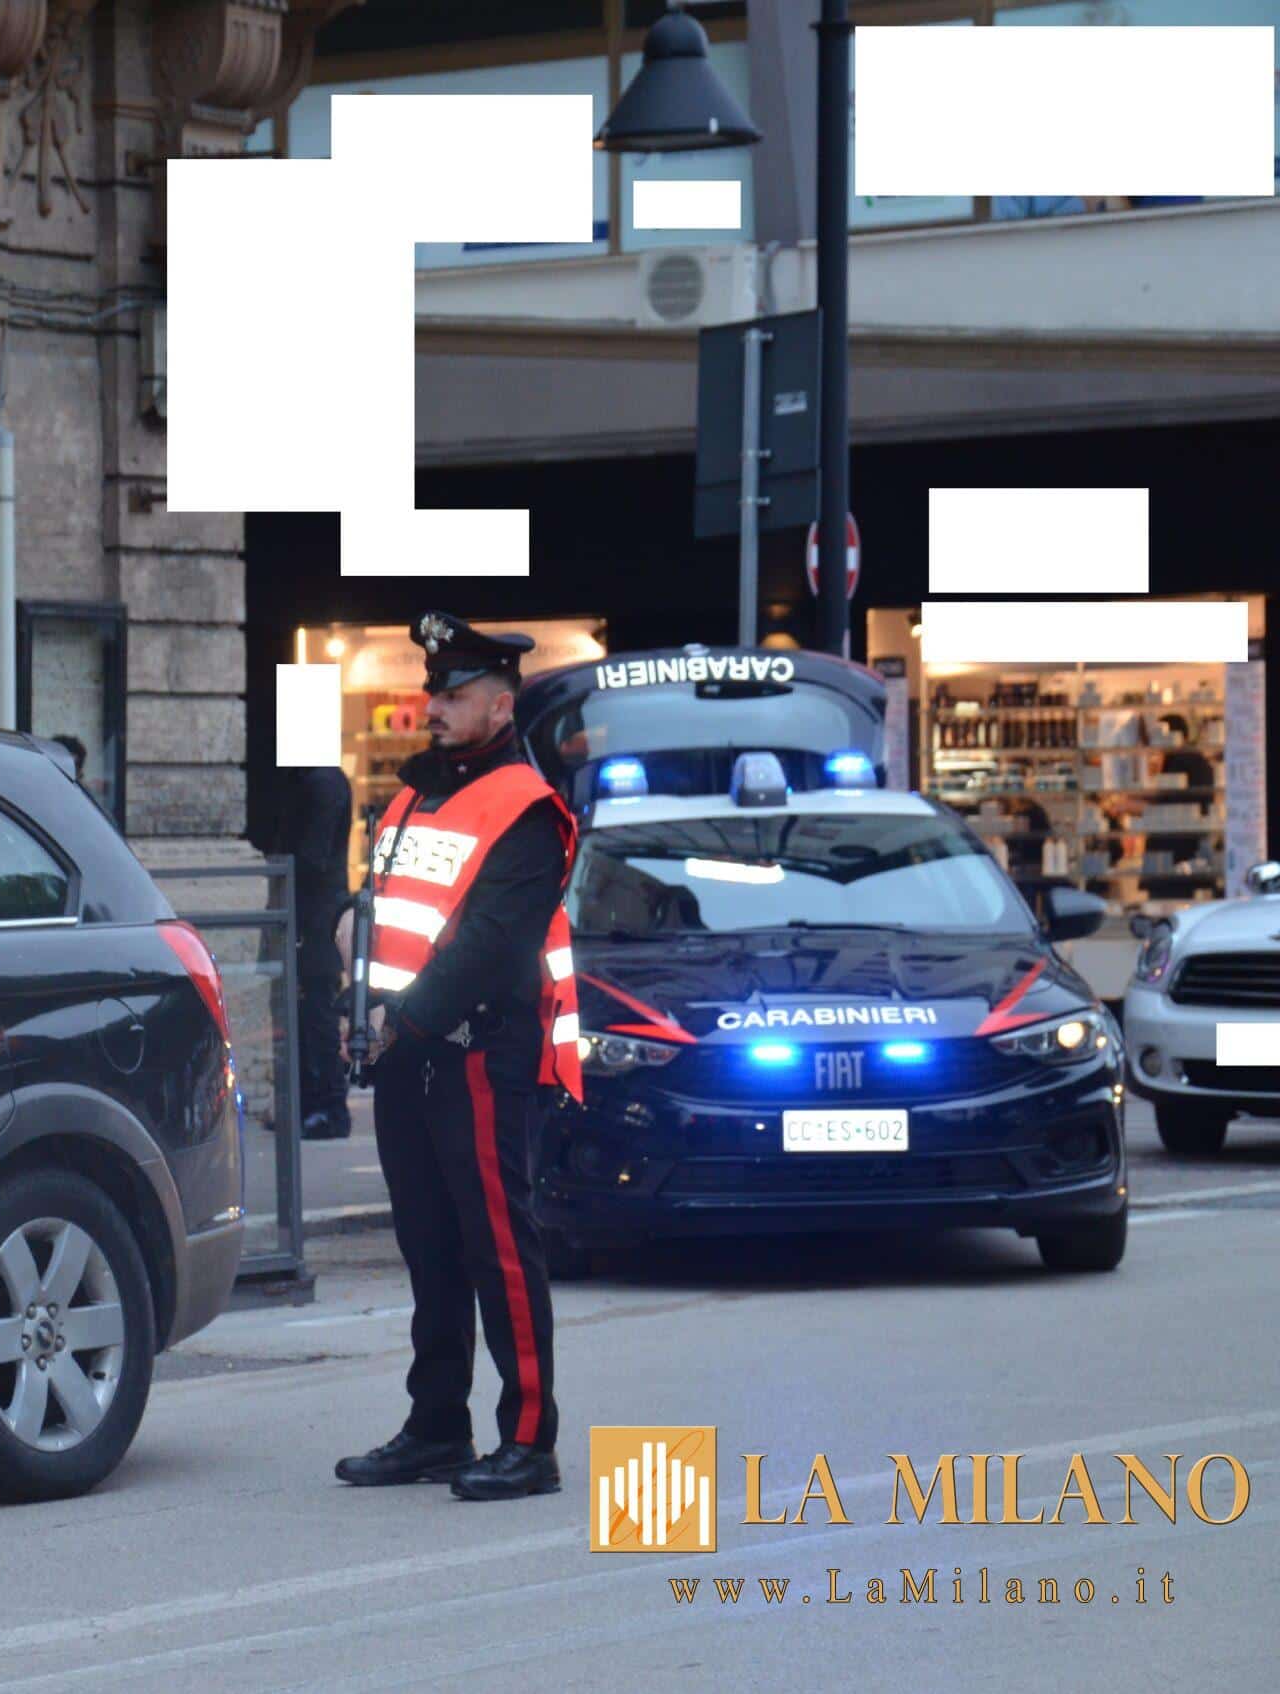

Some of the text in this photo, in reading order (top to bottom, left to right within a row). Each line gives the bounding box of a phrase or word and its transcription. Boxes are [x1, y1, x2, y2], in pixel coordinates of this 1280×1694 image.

[596, 655, 795, 690] CARABINIERI
[716, 1006, 938, 1030] CARABINIERI
[813, 1050, 865, 1091] FIAT
